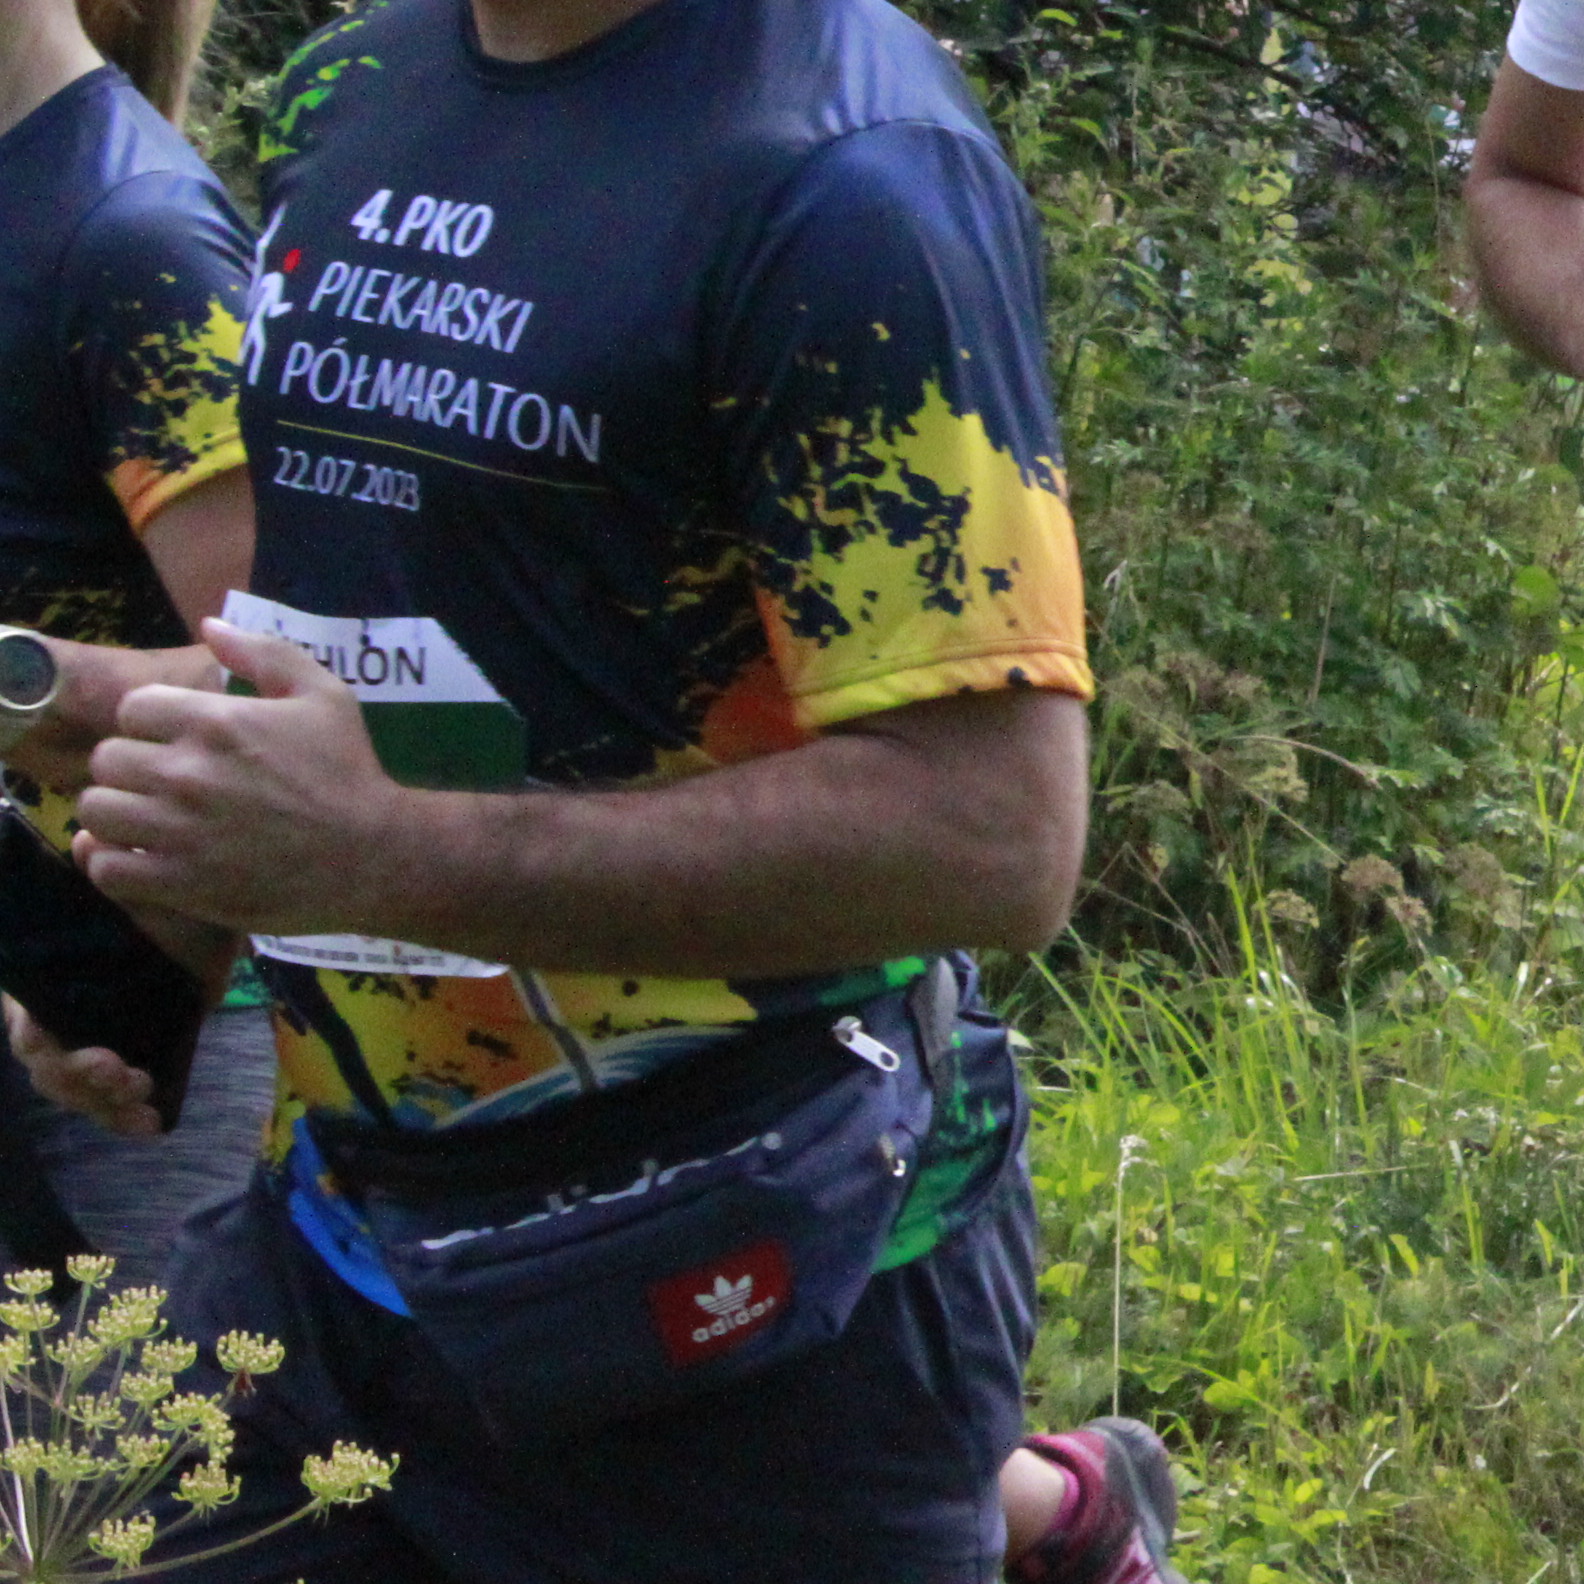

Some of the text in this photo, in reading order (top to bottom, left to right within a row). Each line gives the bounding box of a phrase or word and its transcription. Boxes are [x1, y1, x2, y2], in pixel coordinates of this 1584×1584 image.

[308, 261, 535, 354] PIEKARSKI
[279, 336, 602, 464] PÓŁMARATON
[691, 1296, 777, 1343] adidas
